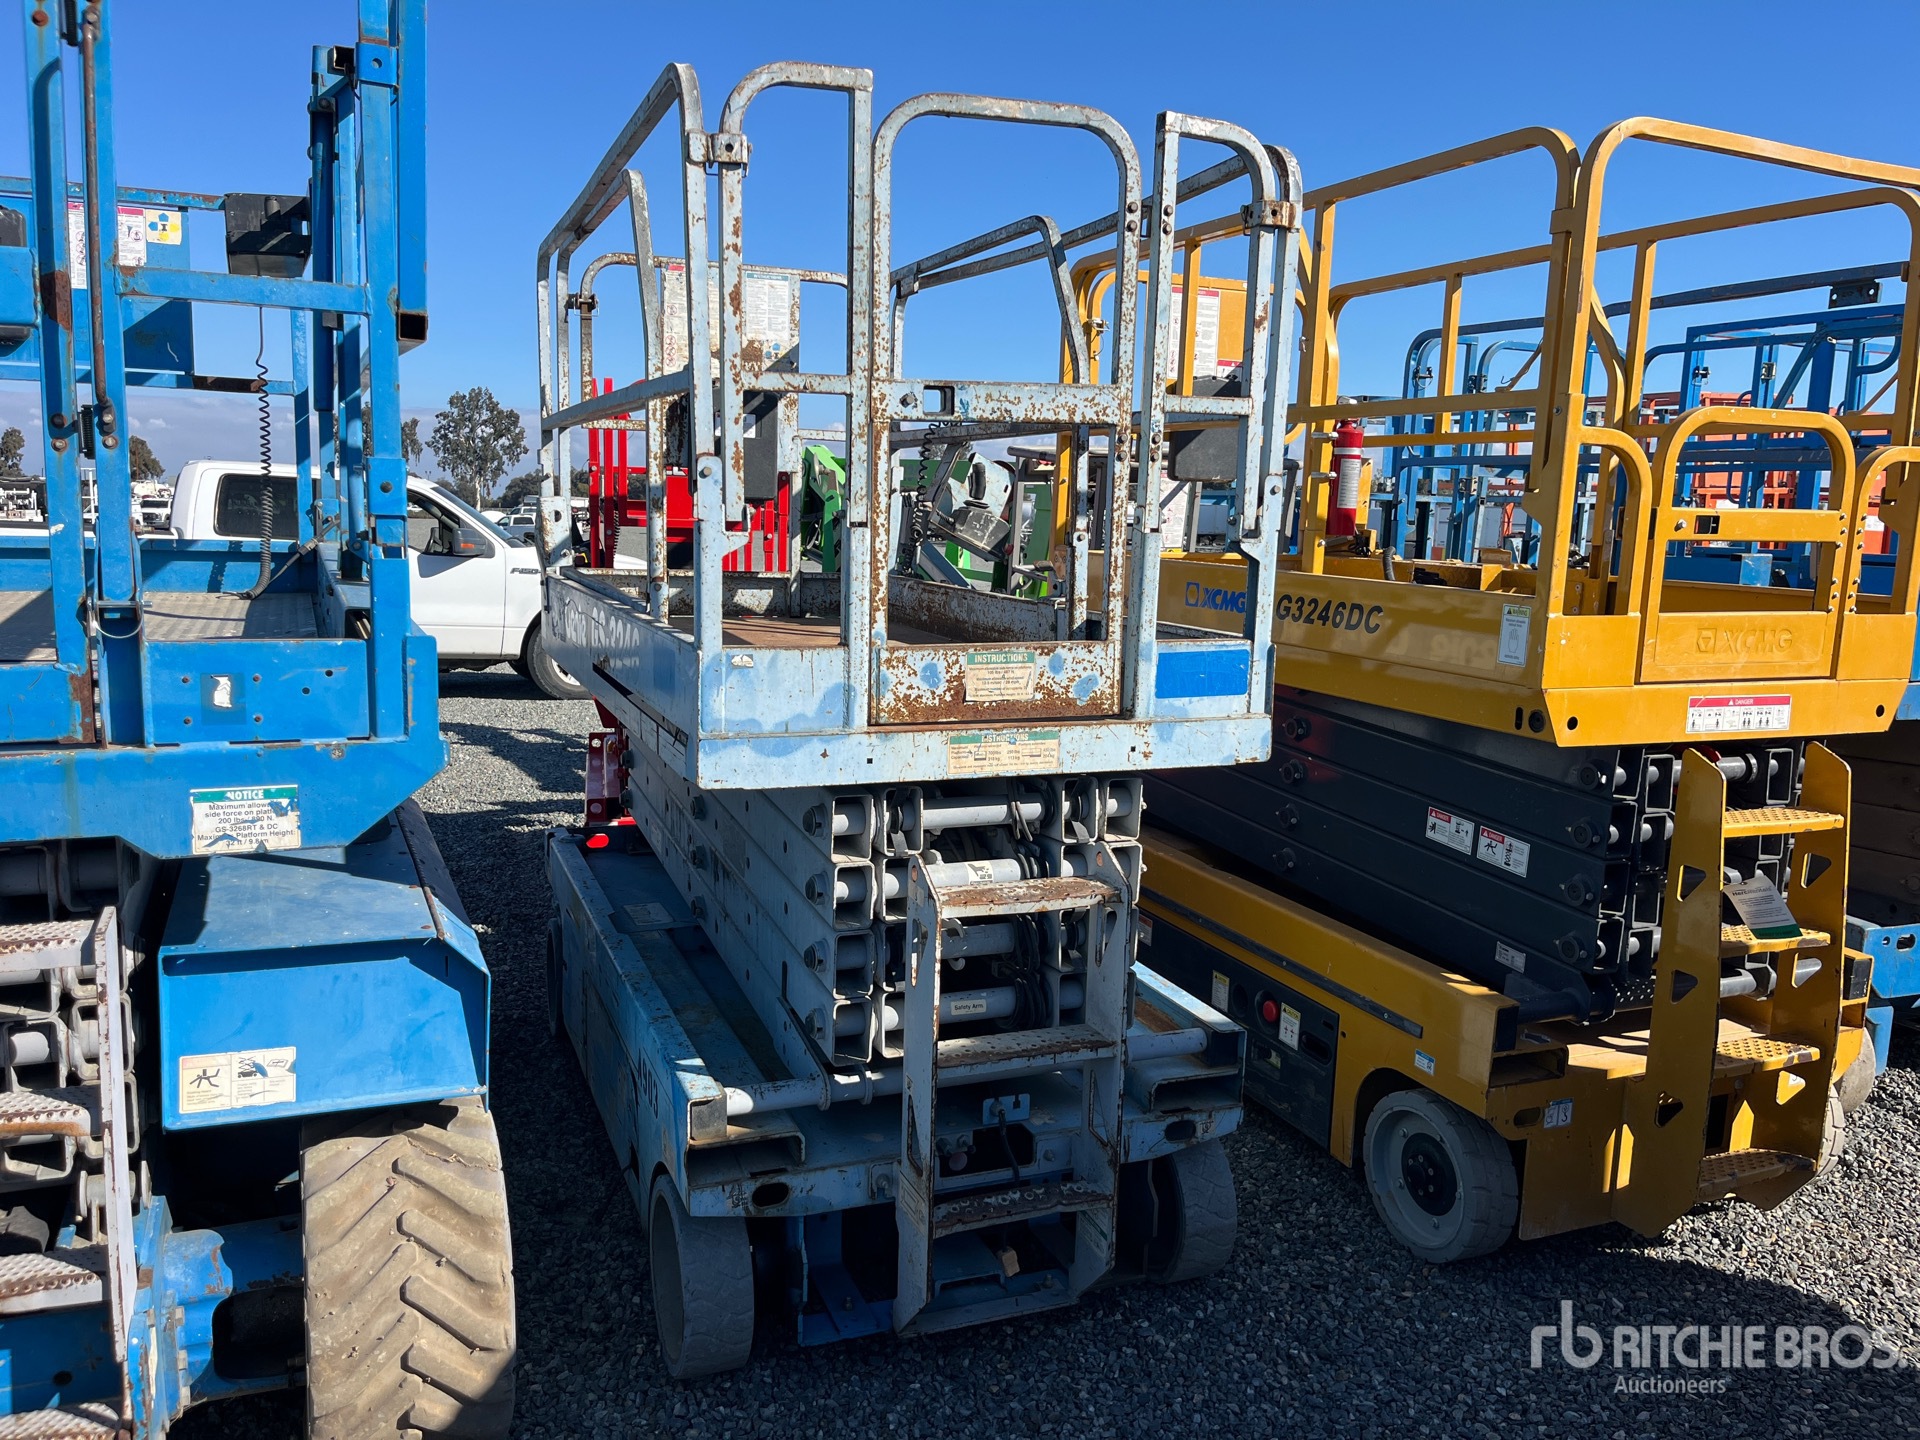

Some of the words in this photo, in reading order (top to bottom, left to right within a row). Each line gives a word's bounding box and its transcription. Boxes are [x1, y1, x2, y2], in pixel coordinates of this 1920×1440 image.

[1201, 587, 1246, 613] XCMG
[1276, 594, 1384, 634] G3246DC
[1724, 628, 1793, 654] XCMG
[974, 653, 1028, 663] INSTRUCTIONS
[225, 789, 264, 800] NOTICE
[215, 825, 257, 833] GS-3268RT
[269, 830, 296, 838] Height:
